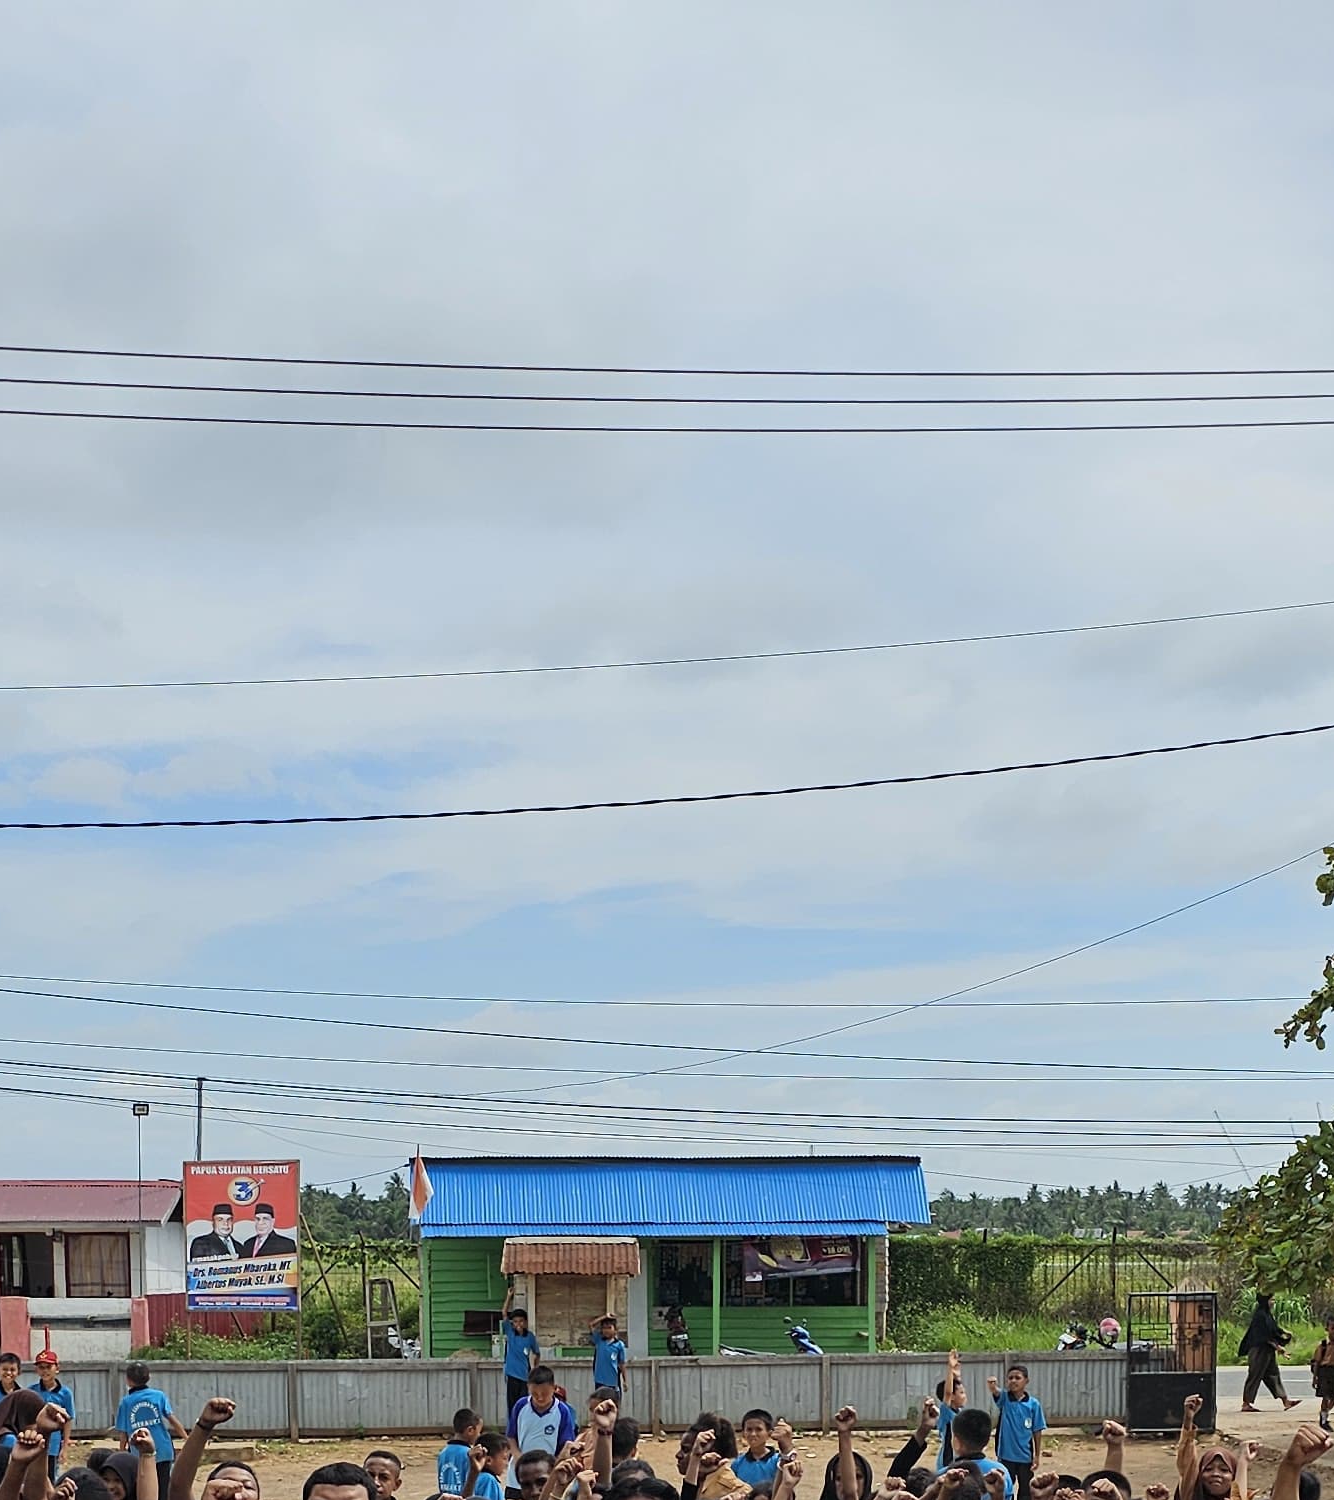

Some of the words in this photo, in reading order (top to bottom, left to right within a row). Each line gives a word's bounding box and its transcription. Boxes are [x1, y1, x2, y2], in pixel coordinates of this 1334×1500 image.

[191, 1166, 217, 1175] PAPUA
[217, 1166, 252, 1175] SELATAN
[253, 1165, 289, 1174] BERSATU
